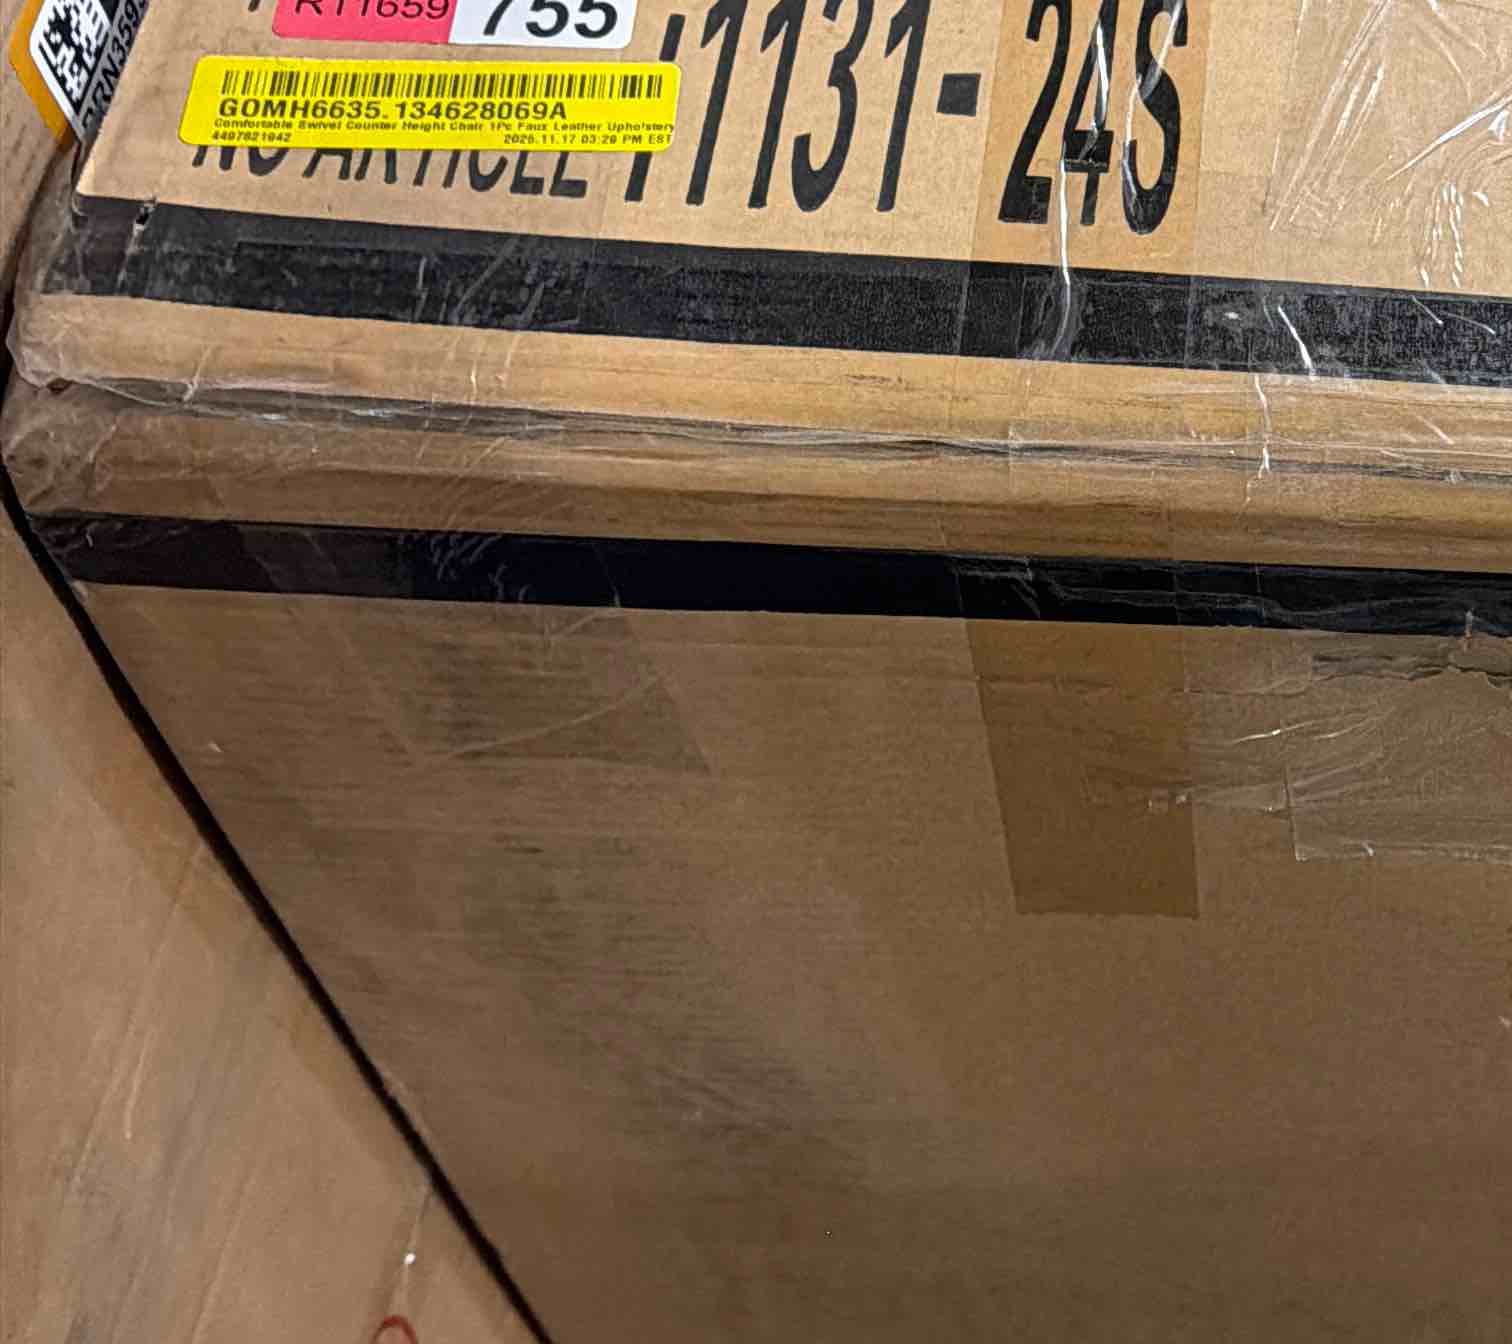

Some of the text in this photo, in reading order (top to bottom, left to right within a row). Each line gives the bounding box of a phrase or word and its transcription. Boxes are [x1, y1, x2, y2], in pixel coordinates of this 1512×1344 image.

[218, 99, 567, 122] GOMH6635.134628069A
[214, 118, 293, 130] Comfortable
[299, 120, 341, 130] Swivel
[346, 121, 397, 131] Counter
[402, 121, 446, 133] Height
[450, 121, 483, 131] Chair
[518, 122, 547, 132] Faux
[553, 122, 601, 132] Leather
